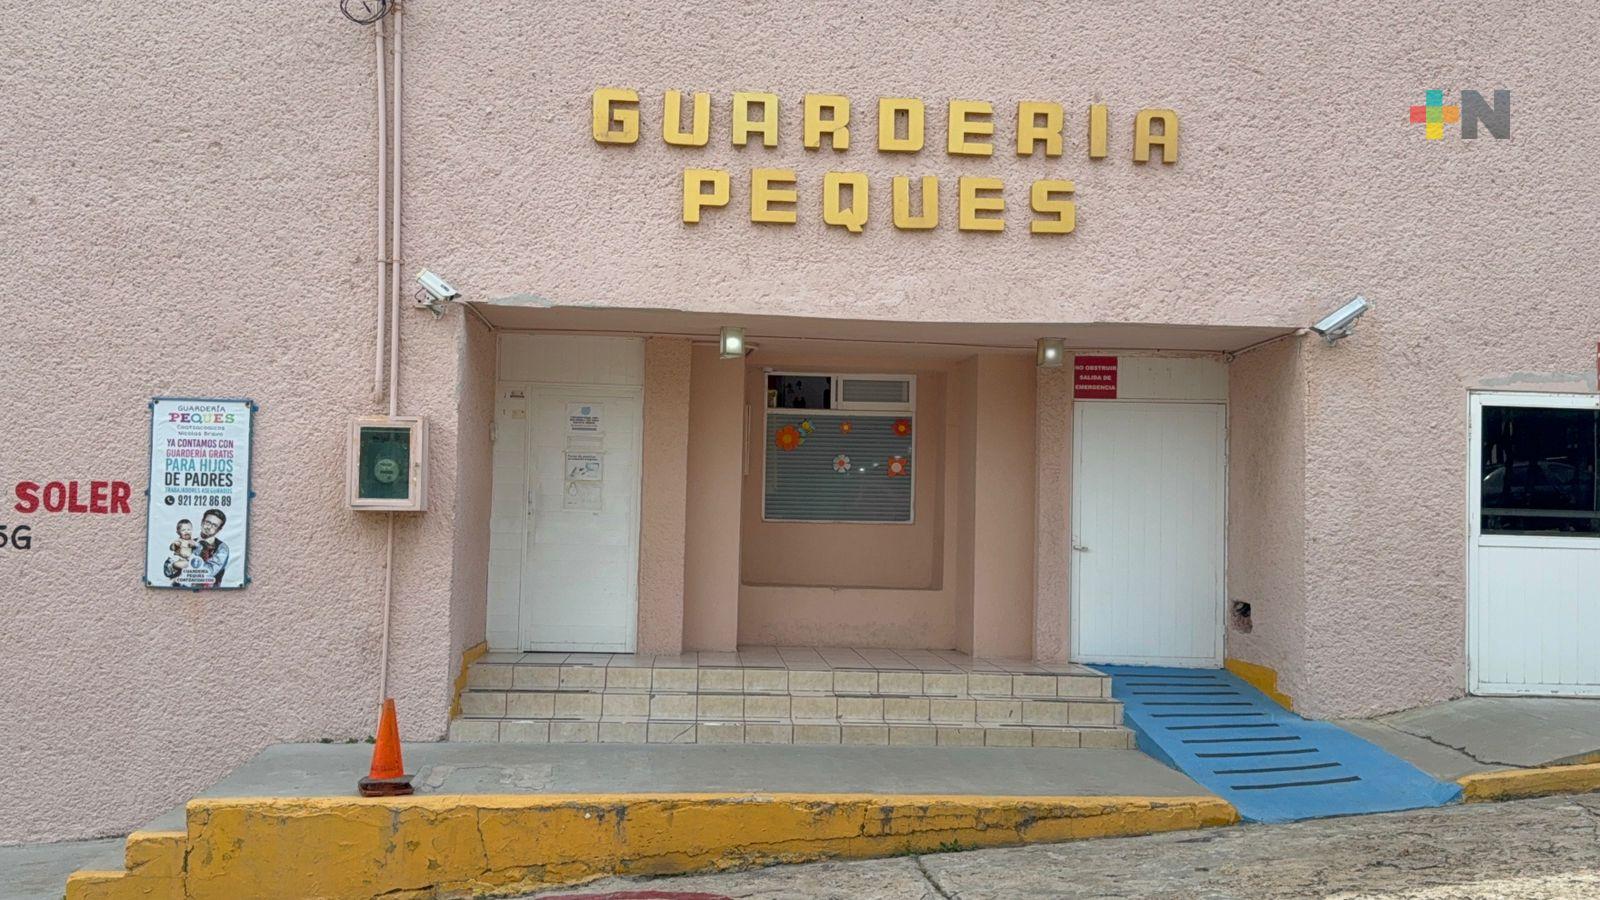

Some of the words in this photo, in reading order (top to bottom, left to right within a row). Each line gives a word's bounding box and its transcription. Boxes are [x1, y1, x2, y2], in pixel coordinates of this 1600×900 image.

[592, 88, 1180, 164] GUARDERIA
[683, 168, 1076, 234] PEQUES
[168, 412, 235, 424] PEQUES
[166, 438, 176, 448] YA
[177, 438, 217, 449] CONTAMOS
[218, 439, 234, 449] CON
[166, 448, 207, 458] GUARDERÍA
[208, 449, 234, 459] GRATIS
[165, 458, 196, 472] PARA
[199, 458, 234, 473] HIJOS
[165, 472, 181, 487] DE
[184, 472, 234, 488] PADRES
[14, 480, 132, 514] SOLER
[177, 494, 192, 506] 921
[193, 495, 208, 507] 212
